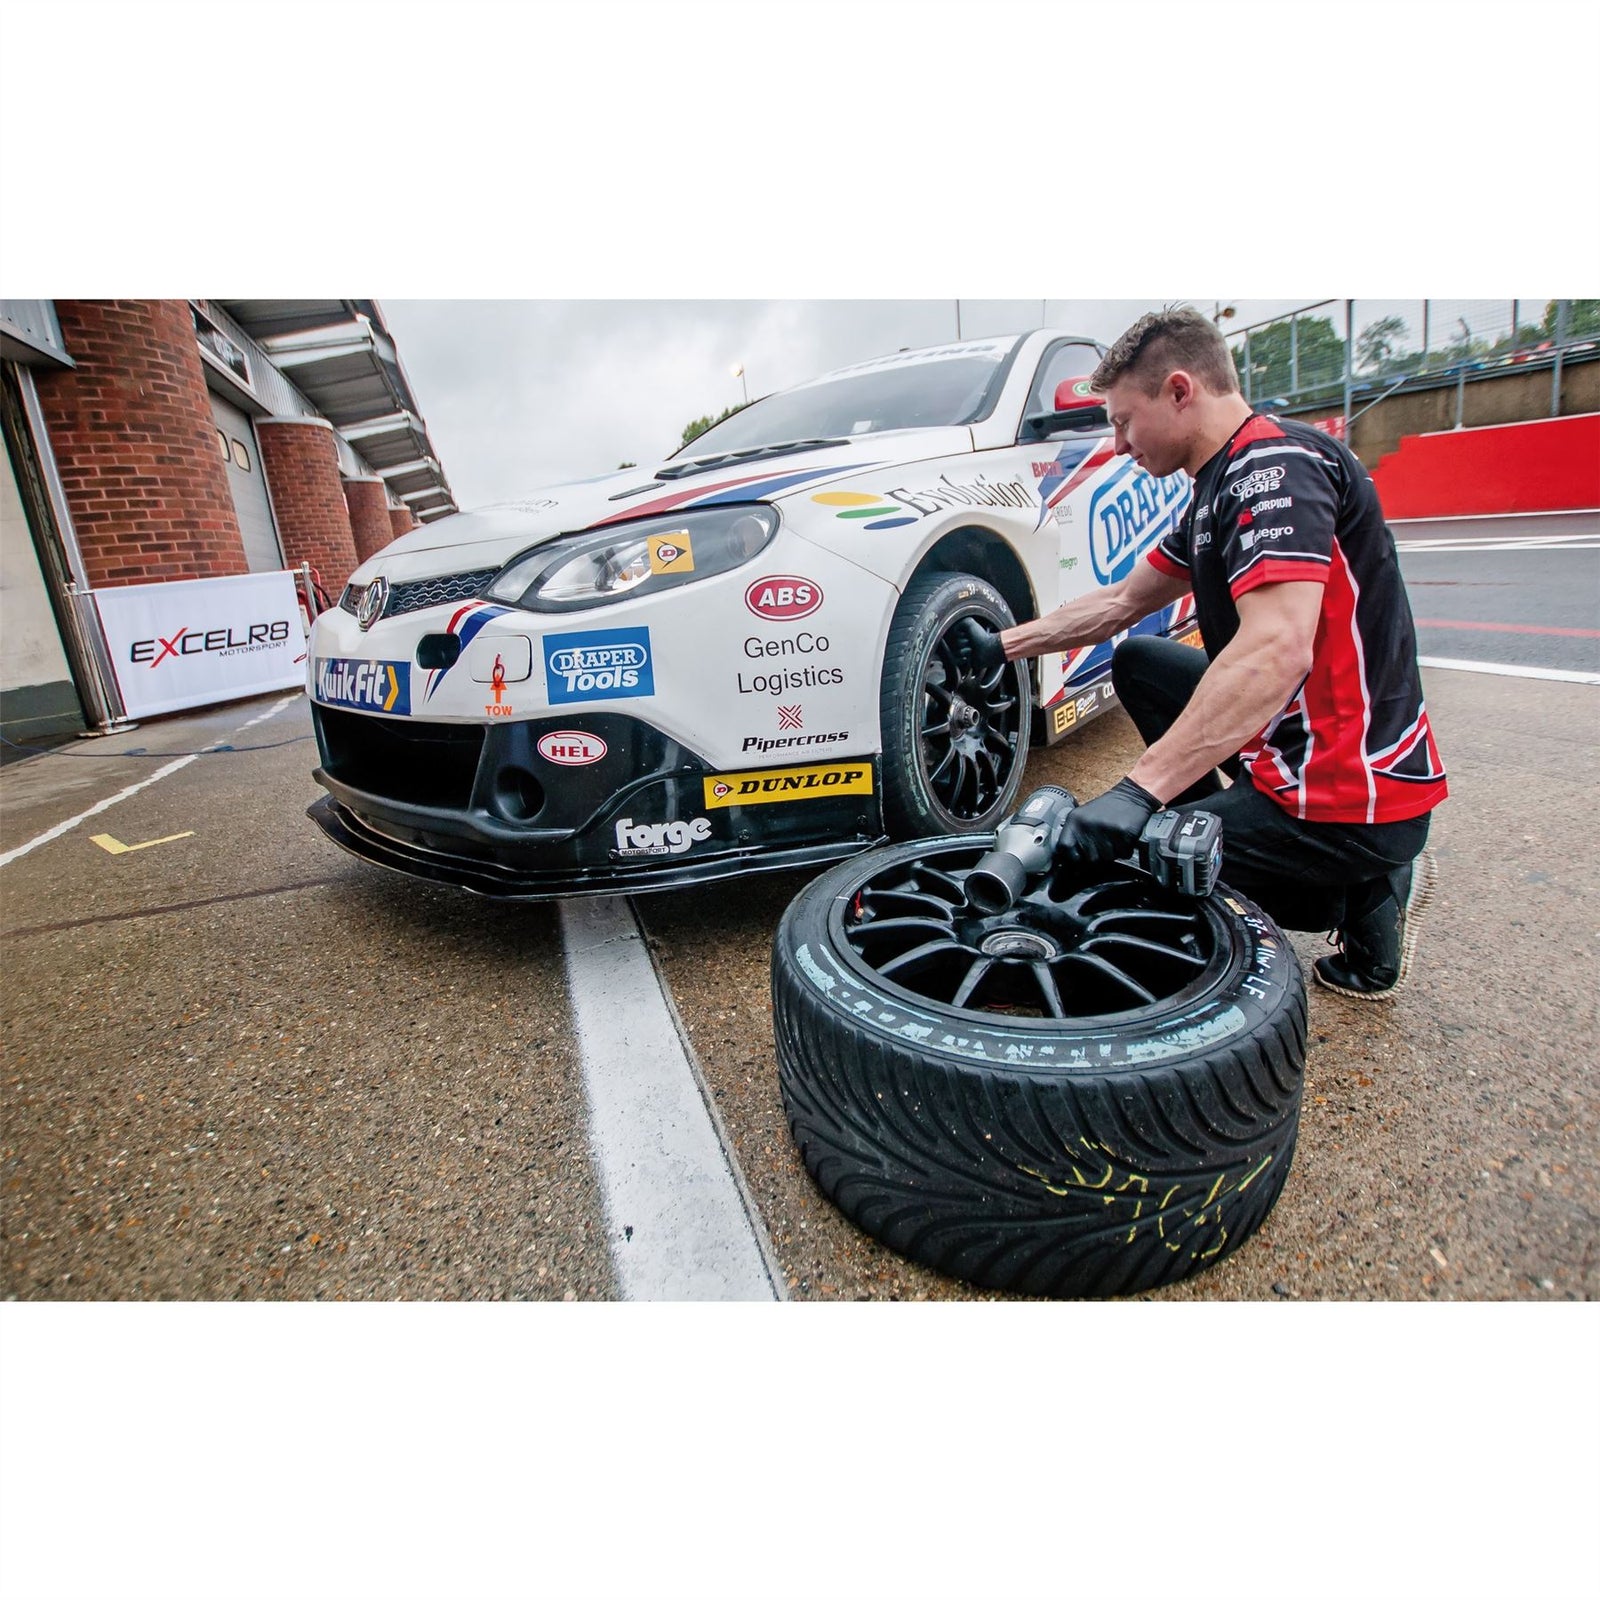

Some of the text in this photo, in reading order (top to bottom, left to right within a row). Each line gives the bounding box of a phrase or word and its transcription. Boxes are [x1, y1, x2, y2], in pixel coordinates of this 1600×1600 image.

[1235, 470, 1280, 493] DRAPER
[1240, 480, 1281, 503] Tools
[884, 474, 1039, 518] Evolution
[1251, 496, 1293, 517] SCORPION
[758, 585, 812, 607] ABS
[131, 621, 289, 668] EXCELR8
[219, 641, 288, 657] MOTORSPORT
[744, 632, 829, 659] GenCo
[559, 649, 638, 670] DRAPER
[562, 666, 639, 692] Tools
[738, 665, 844, 696] Logistics
[485, 706, 512, 716] TOW
[551, 745, 595, 757] HEL
[742, 731, 849, 752] Pipercross
[737, 771, 863, 795] DUNLOP
[621, 847, 666, 855] MOTORSPORT
